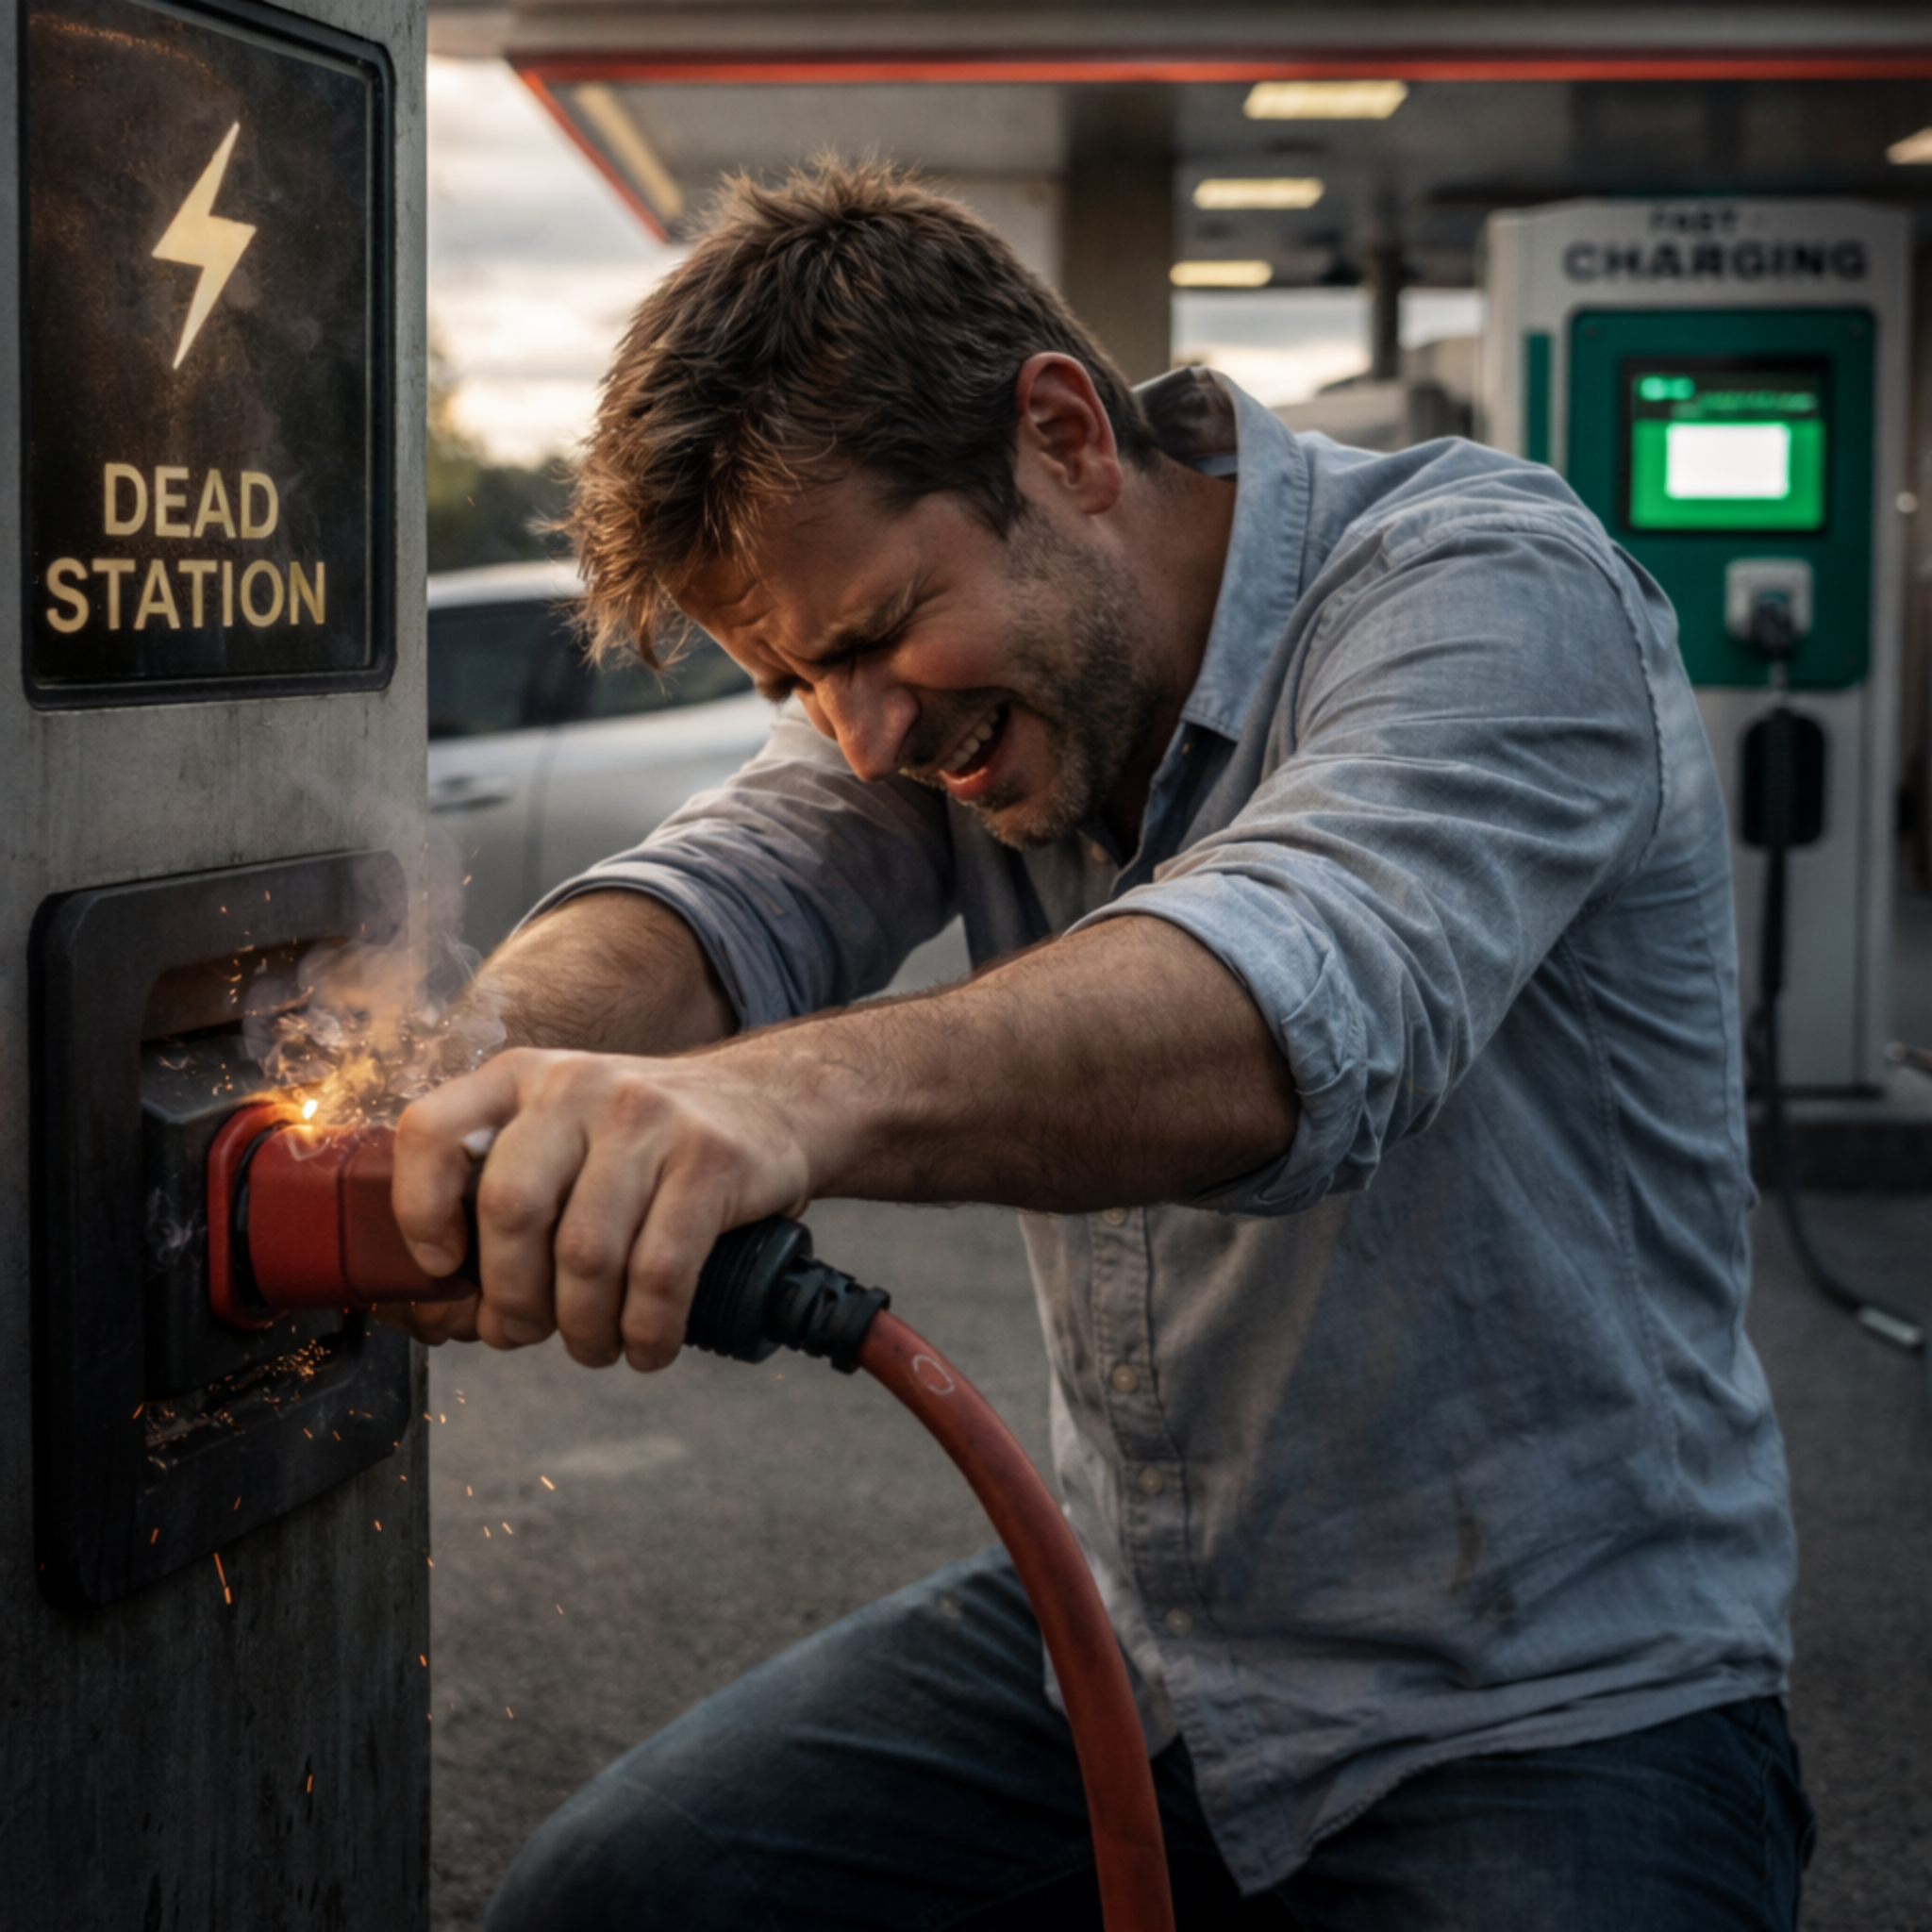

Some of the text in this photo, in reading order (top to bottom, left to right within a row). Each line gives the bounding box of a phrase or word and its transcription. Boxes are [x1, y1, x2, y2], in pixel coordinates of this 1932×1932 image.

[1564, 240, 1869, 281] CHARGING
[104, 462, 279, 539] DEAD
[45, 557, 325, 633] STATION
